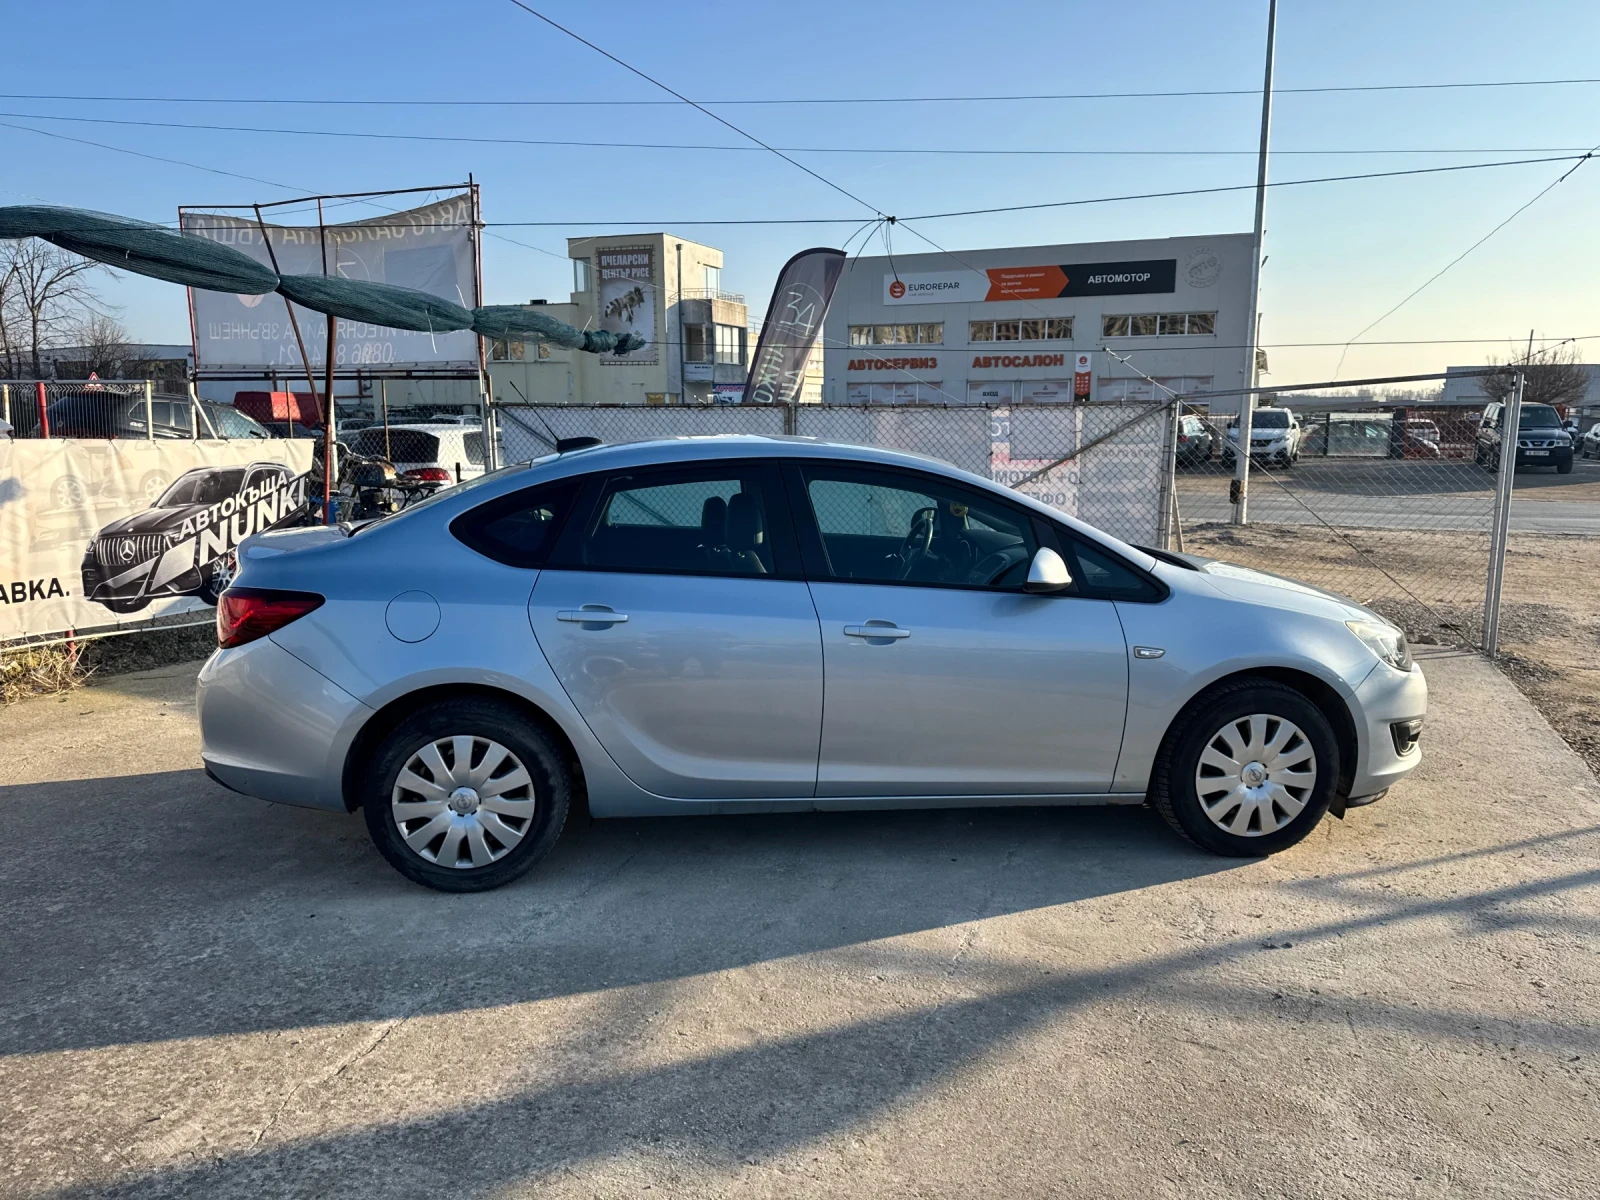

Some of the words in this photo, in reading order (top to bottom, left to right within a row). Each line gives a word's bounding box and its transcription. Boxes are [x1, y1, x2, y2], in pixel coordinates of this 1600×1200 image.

[601, 253, 649, 267] ПЧЕЛАРСКИ
[602, 268, 630, 280] ЦЕНТЪР
[631, 267, 649, 278] РУСЕ
[1088, 273, 1151, 284] АВТОМОТОР
[908, 282, 960, 292] EUROREPAR
[847, 357, 938, 371] АВТОСЕРВИЗ
[972, 354, 1064, 368] АВТОСАЛОН
[179, 470, 289, 541] АВТОКЪЩА
[199, 477, 306, 567] NUNKI
